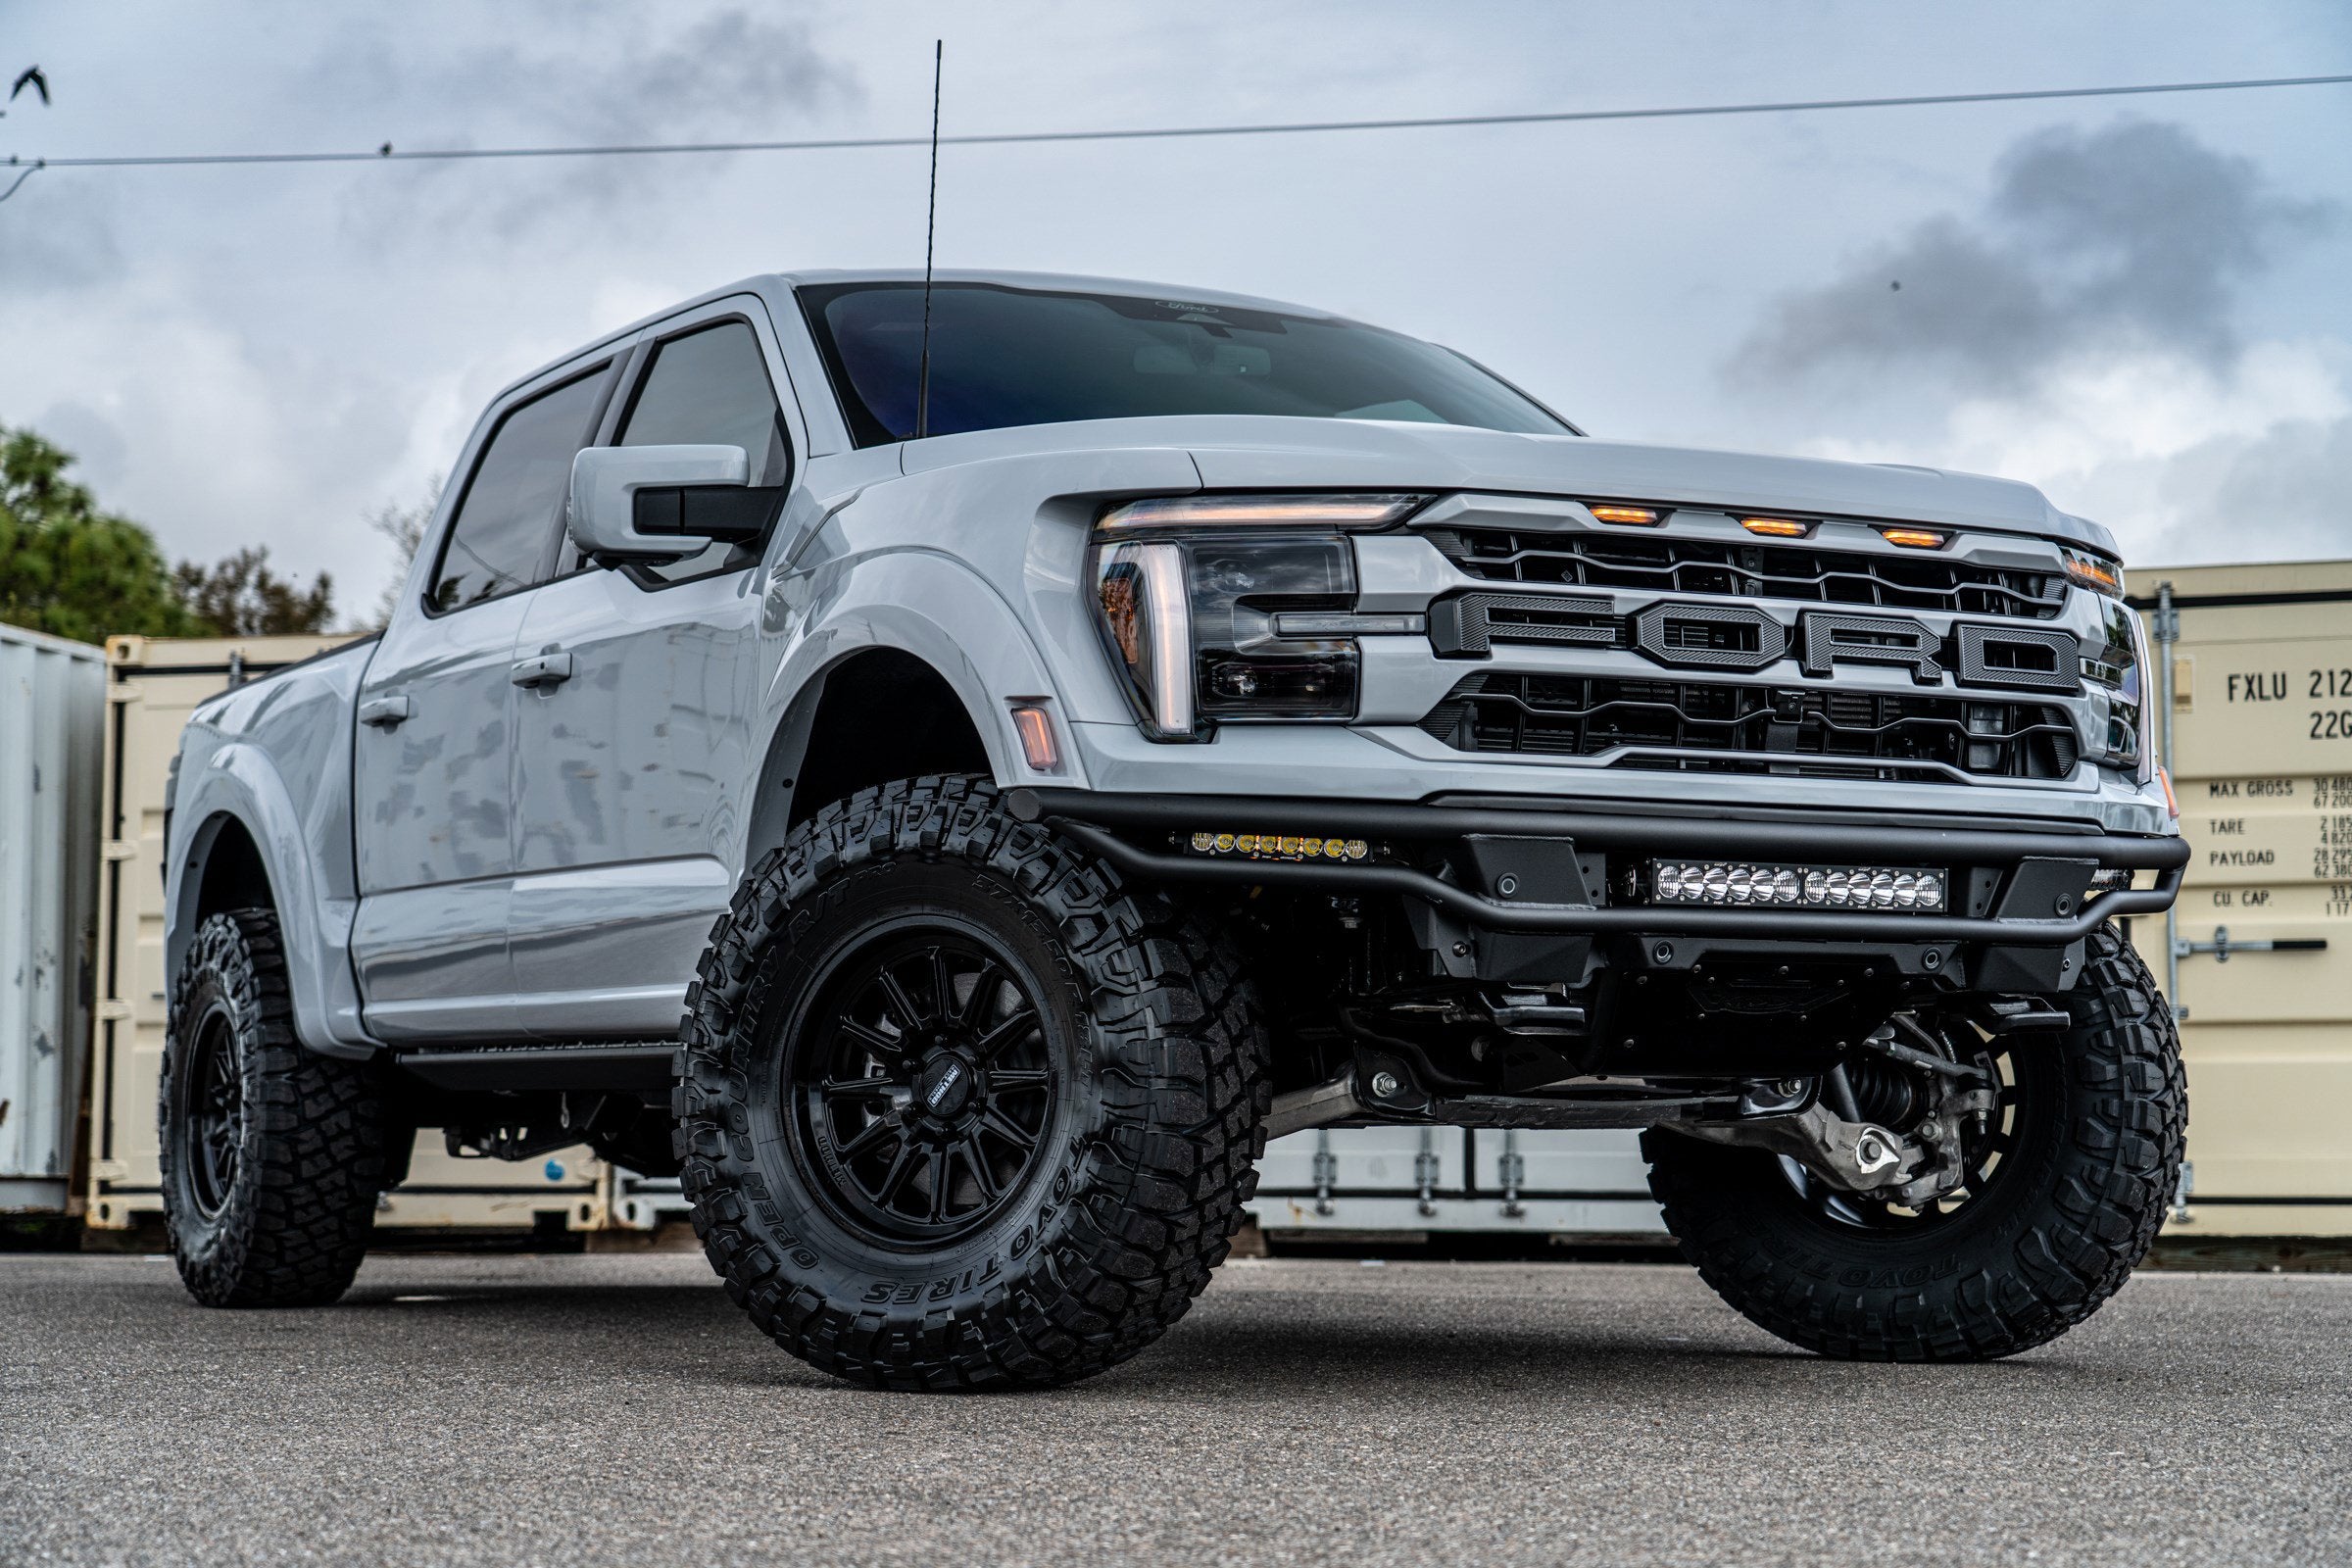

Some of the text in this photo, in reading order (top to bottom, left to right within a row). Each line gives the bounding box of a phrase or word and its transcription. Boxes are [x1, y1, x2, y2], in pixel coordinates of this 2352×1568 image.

[1430, 591, 2080, 692] FORD
[2228, 670, 2287, 703] FXLU
[2209, 781, 2240, 798] MAX
[2247, 779, 2294, 797] GROSS
[2313, 777, 2328, 793] 30
[2209, 819, 2245, 835] TARE
[2210, 850, 2275, 866] PAYLOAD
[728, 945, 781, 1162] COUNTRY
[740, 1171, 820, 1271] OPEN
[859, 1134, 1086, 1305] TOYO TIRES
[1838, 1251, 1961, 1289] TOYO
